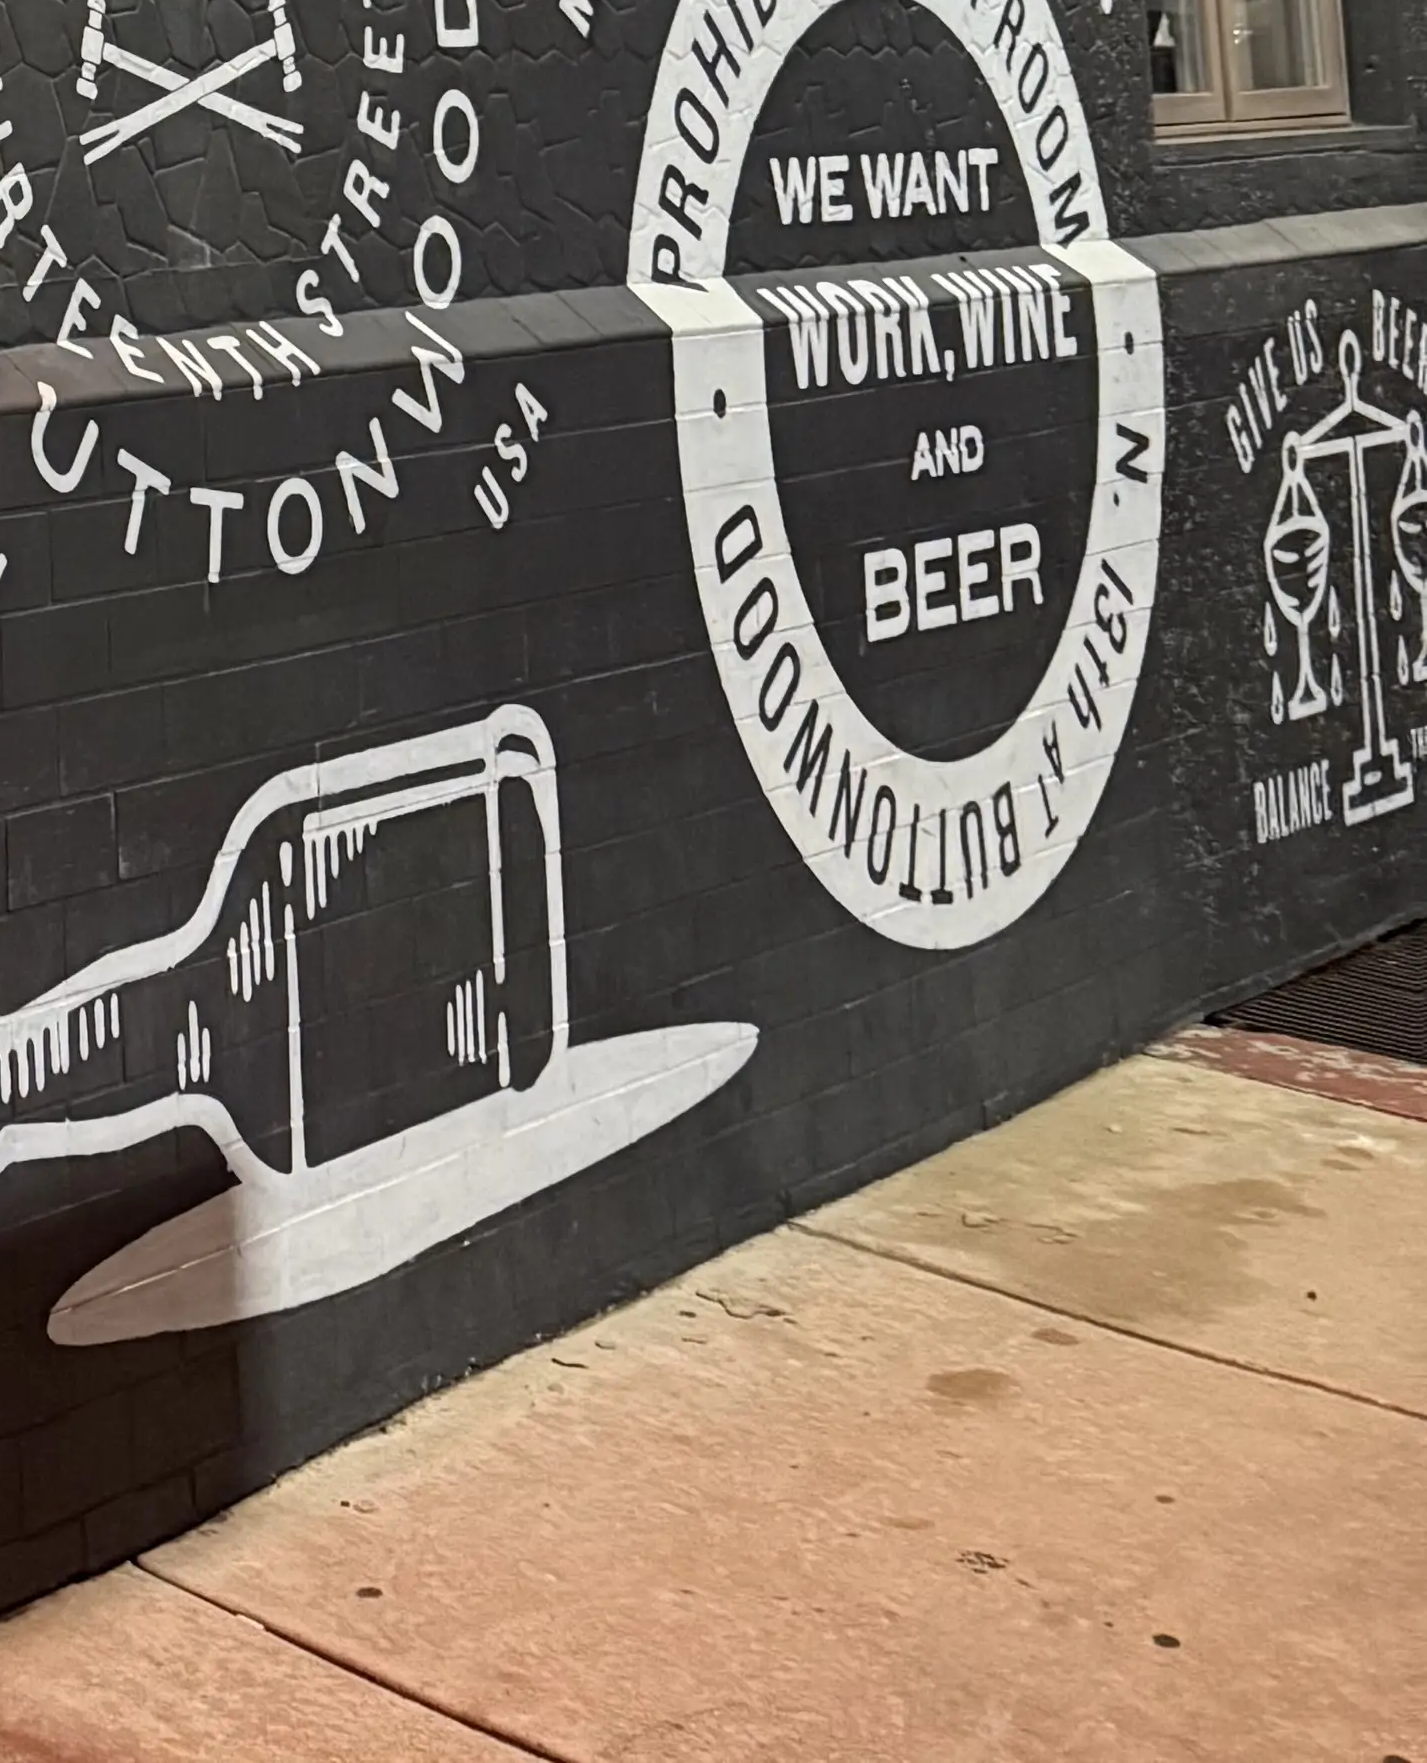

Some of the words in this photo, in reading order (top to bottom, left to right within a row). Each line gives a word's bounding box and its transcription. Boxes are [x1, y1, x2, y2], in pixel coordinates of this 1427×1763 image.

[770, 155, 853, 225] WE
[860, 147, 998, 219] WANT
[1226, 337, 1287, 473] GIVE
[1287, 299, 1322, 385] US
[474, 382, 548, 529] USA
[911, 424, 984, 481] AND
[864, 523, 1043, 643] BEER
[714, 504, 1020, 904] BUTTONWOOD
[1037, 720, 1065, 837] AT
[1253, 760, 1333, 844] BALANCE
